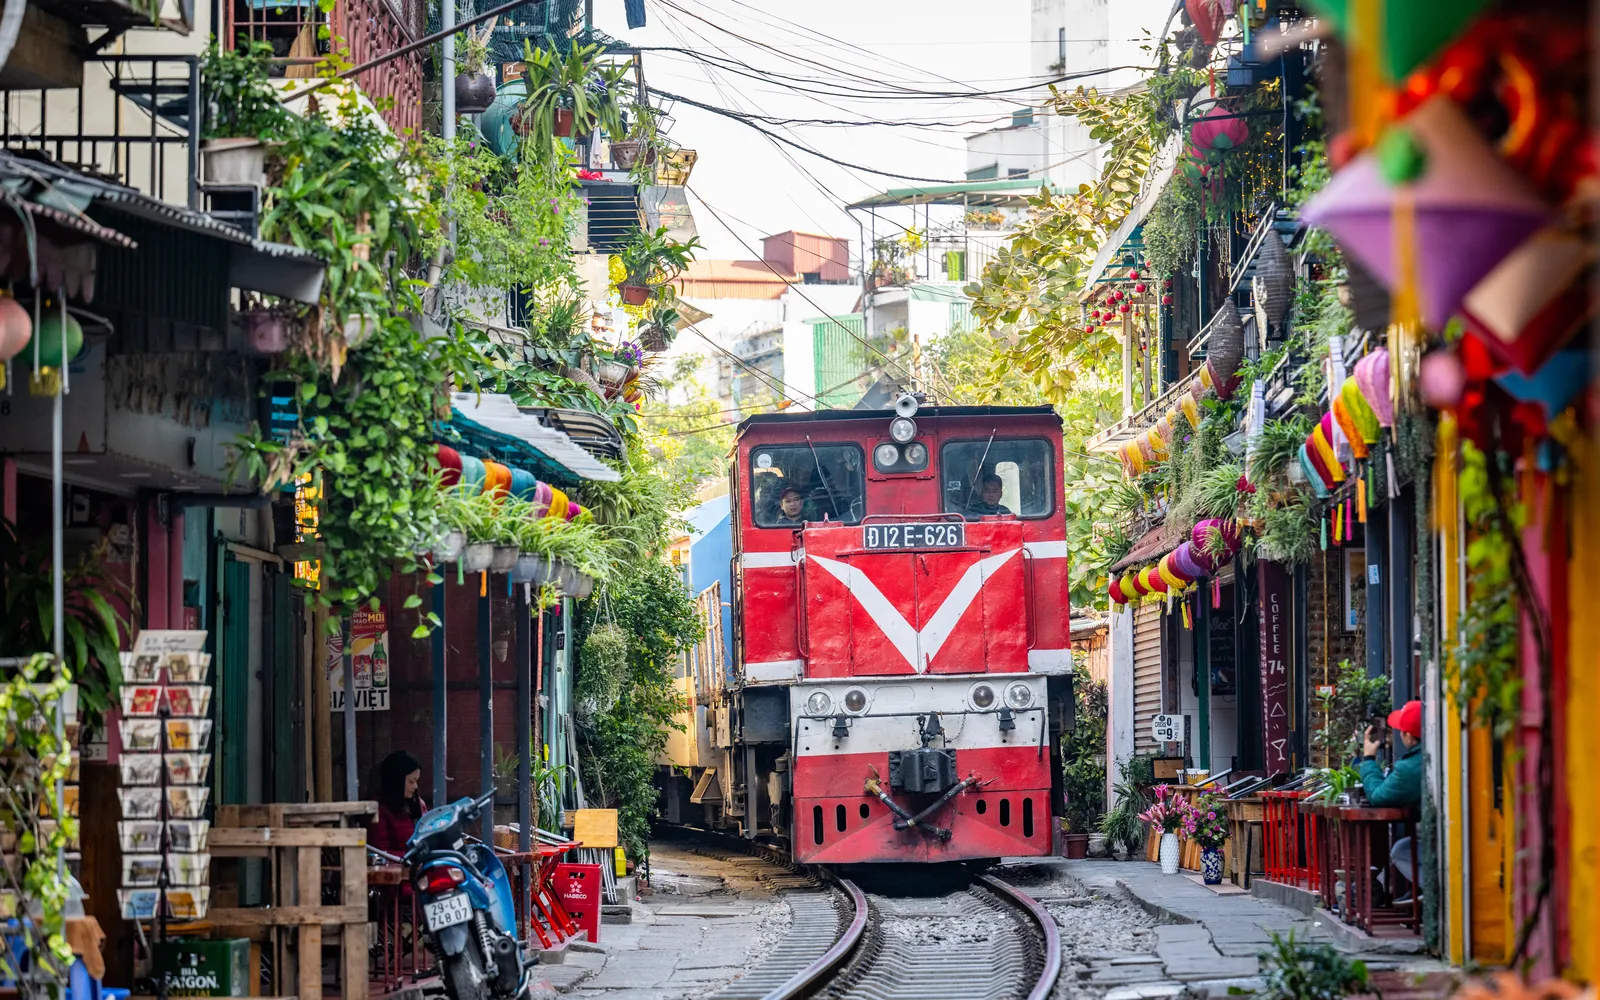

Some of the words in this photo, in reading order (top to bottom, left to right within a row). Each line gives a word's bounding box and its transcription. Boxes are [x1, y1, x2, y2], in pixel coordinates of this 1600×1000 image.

[1271, 593, 1280, 654] COFFEE
[1268, 660, 1285, 675] 74
[431, 897, 462, 916] 29-C1
[181, 968, 198, 976] BIA
